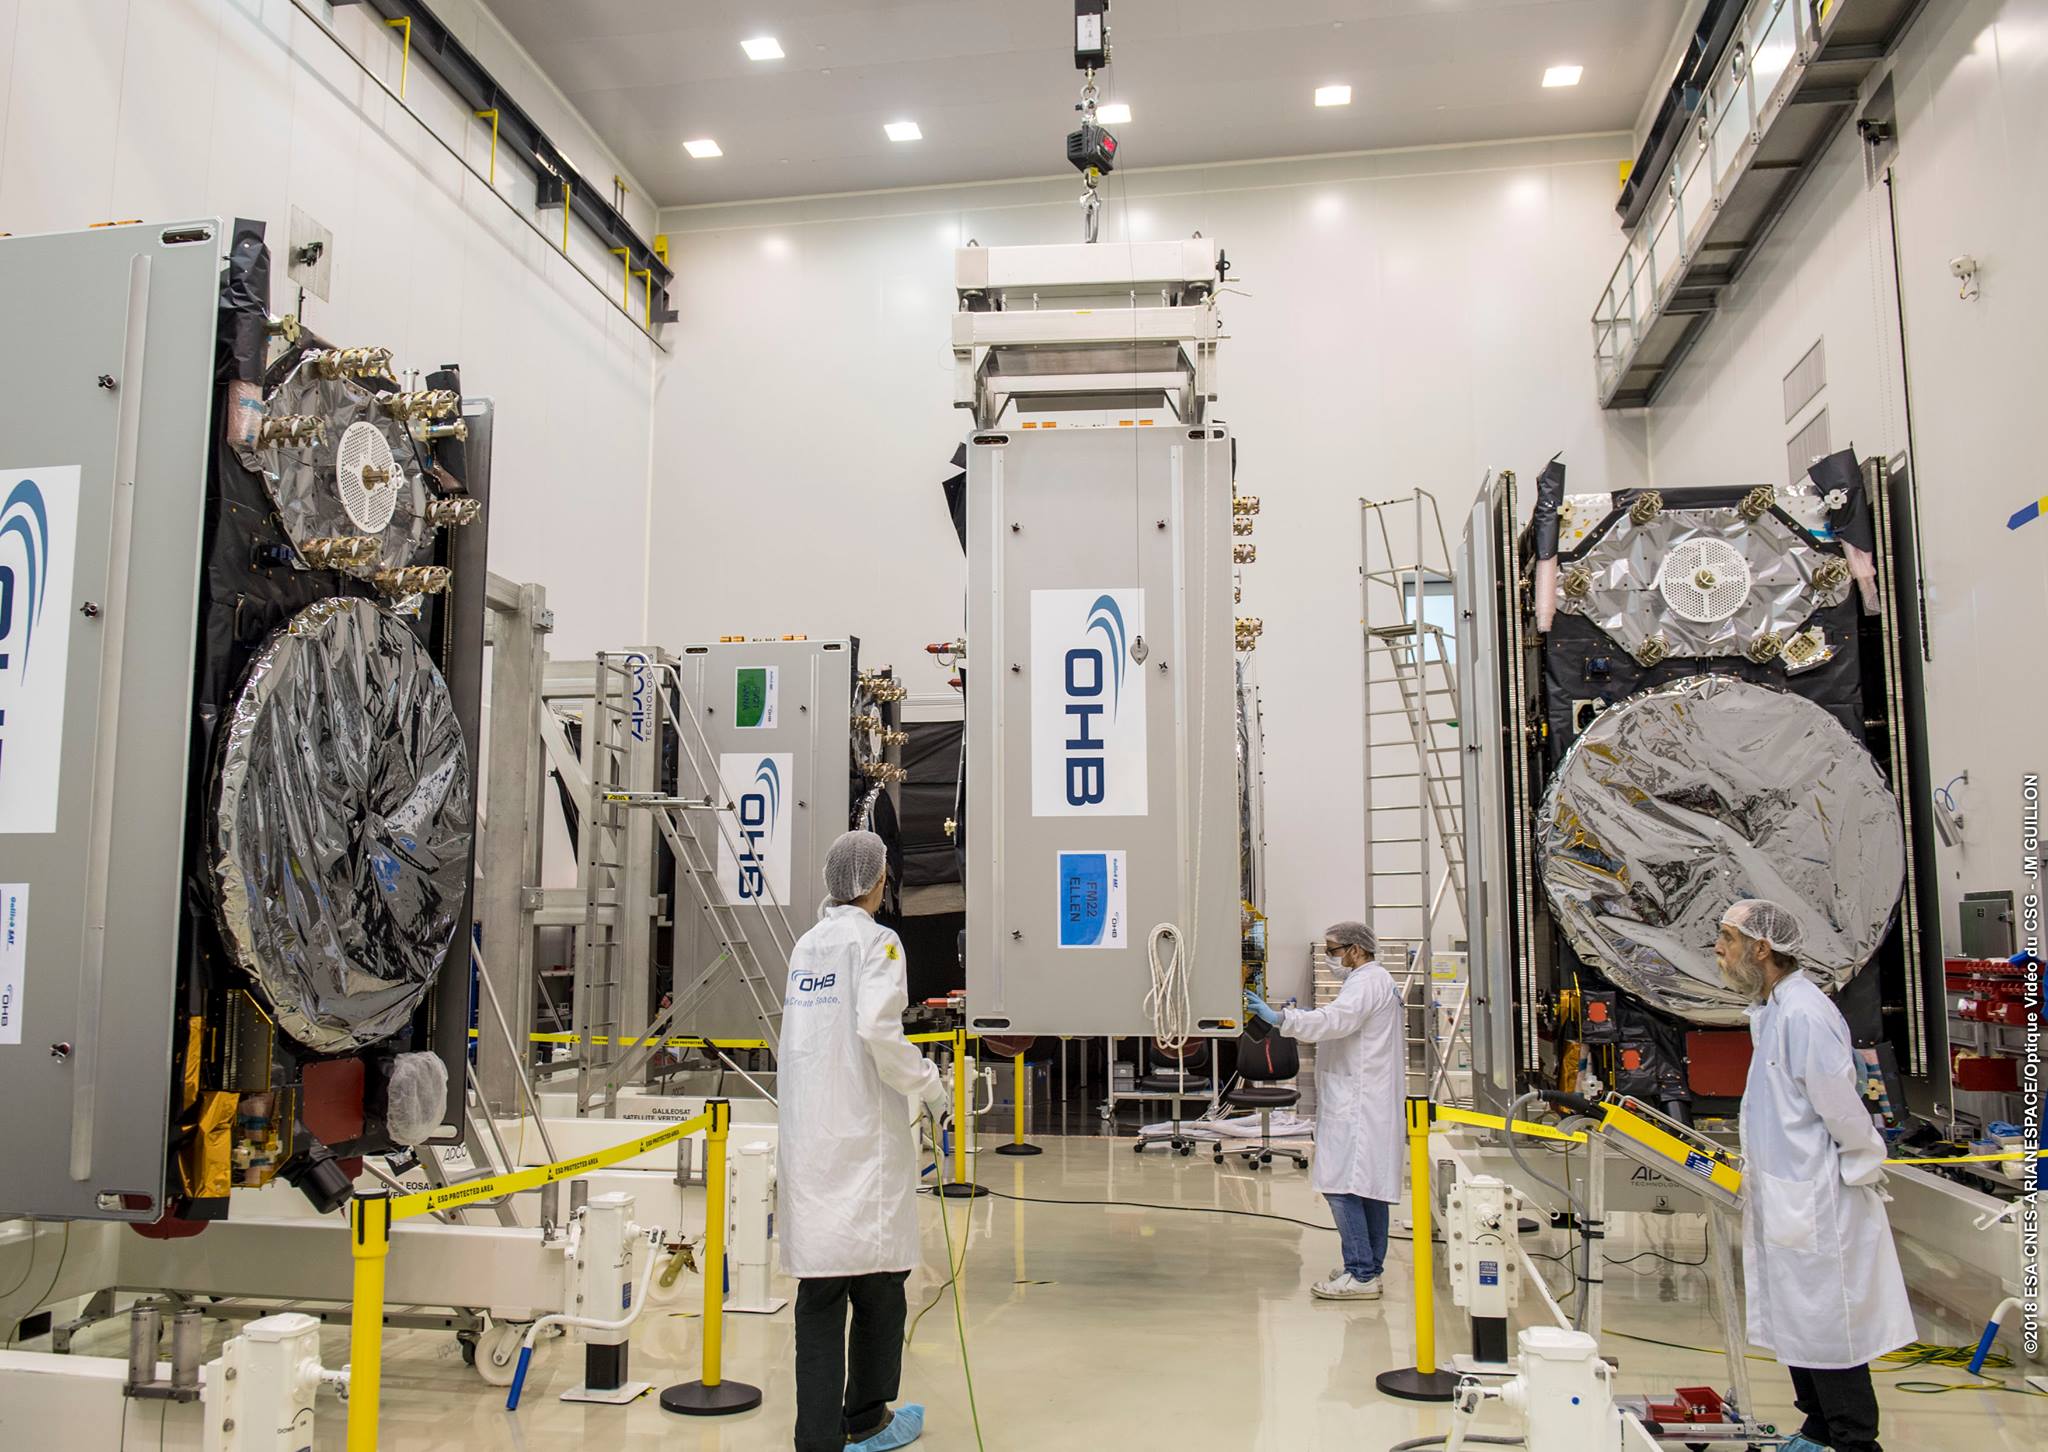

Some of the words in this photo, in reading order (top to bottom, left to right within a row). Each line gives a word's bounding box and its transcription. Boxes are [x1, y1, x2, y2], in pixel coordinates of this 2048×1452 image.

[1064, 648, 1105, 806] OHB
[738, 793, 765, 899] OHB
[1070, 877, 1081, 922] ELLEN
[1086, 882, 1098, 917] FM22
[799, 973, 836, 992] OHB
[1, 994, 9, 1026] OHB
[437, 1195, 448, 1203] ESD
[449, 1187, 480, 1202] PROTECTED
[481, 1184, 494, 1193] AREA
